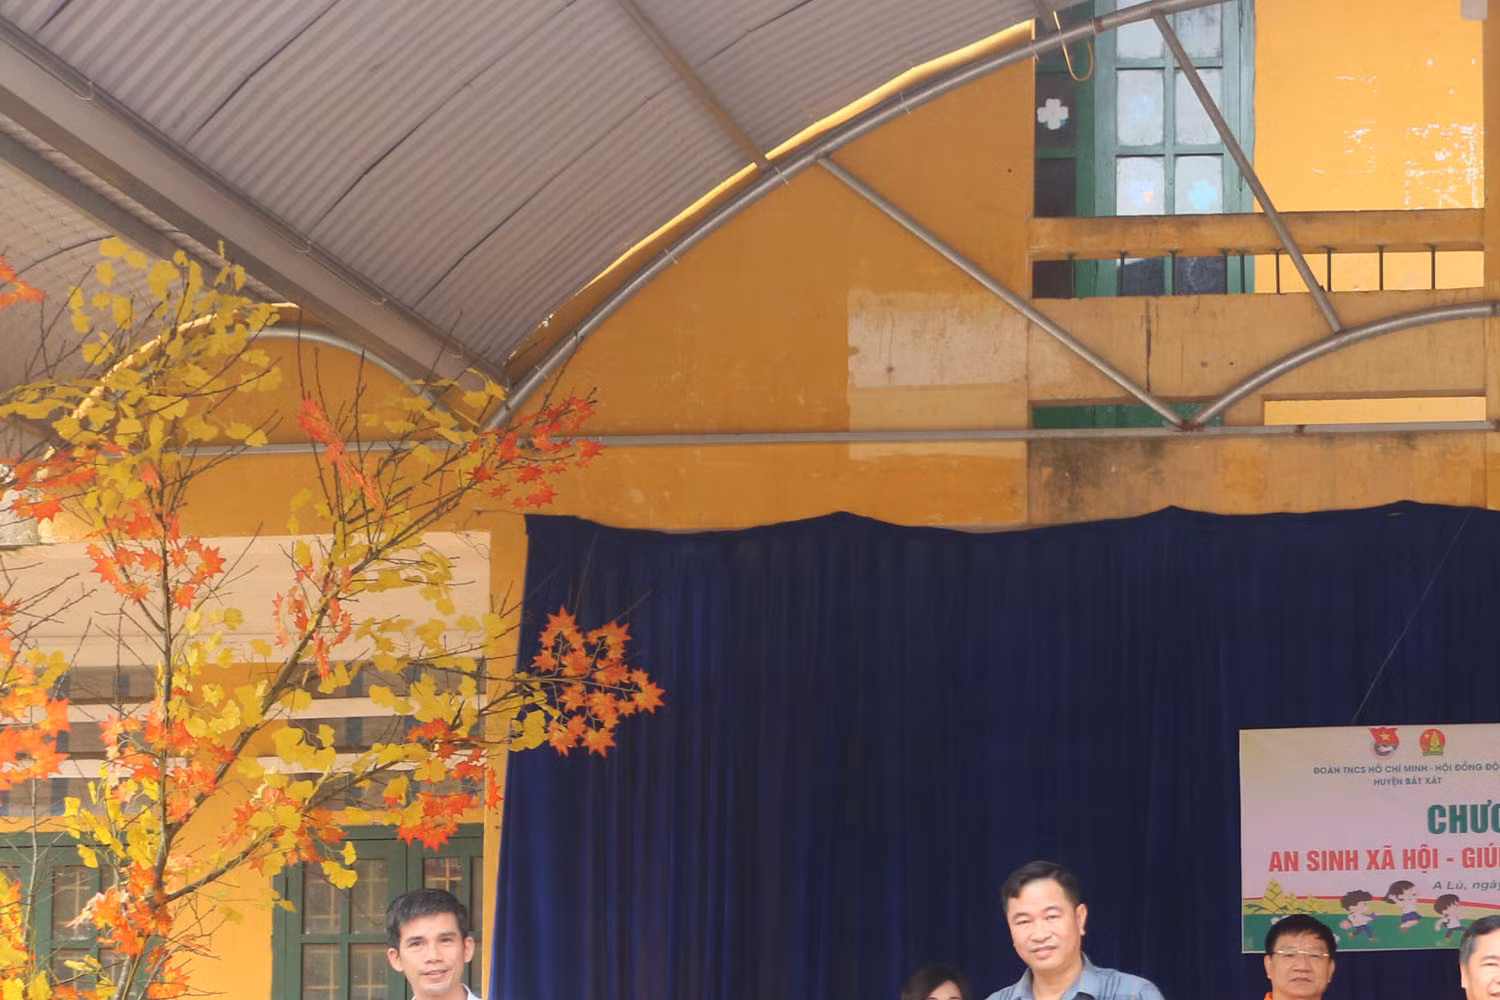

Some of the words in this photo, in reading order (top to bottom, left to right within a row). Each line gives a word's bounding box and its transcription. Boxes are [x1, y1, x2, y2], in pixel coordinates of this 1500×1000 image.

[1343, 765, 1366, 774] TNCS
[1403, 764, 1428, 773] MINH
[1268, 851, 1299, 872] AN
[1306, 849, 1359, 872] SINH
[1366, 845, 1396, 871] XÃ
[1402, 844, 1439, 874] HỘI
[1432, 881, 1442, 890] A
